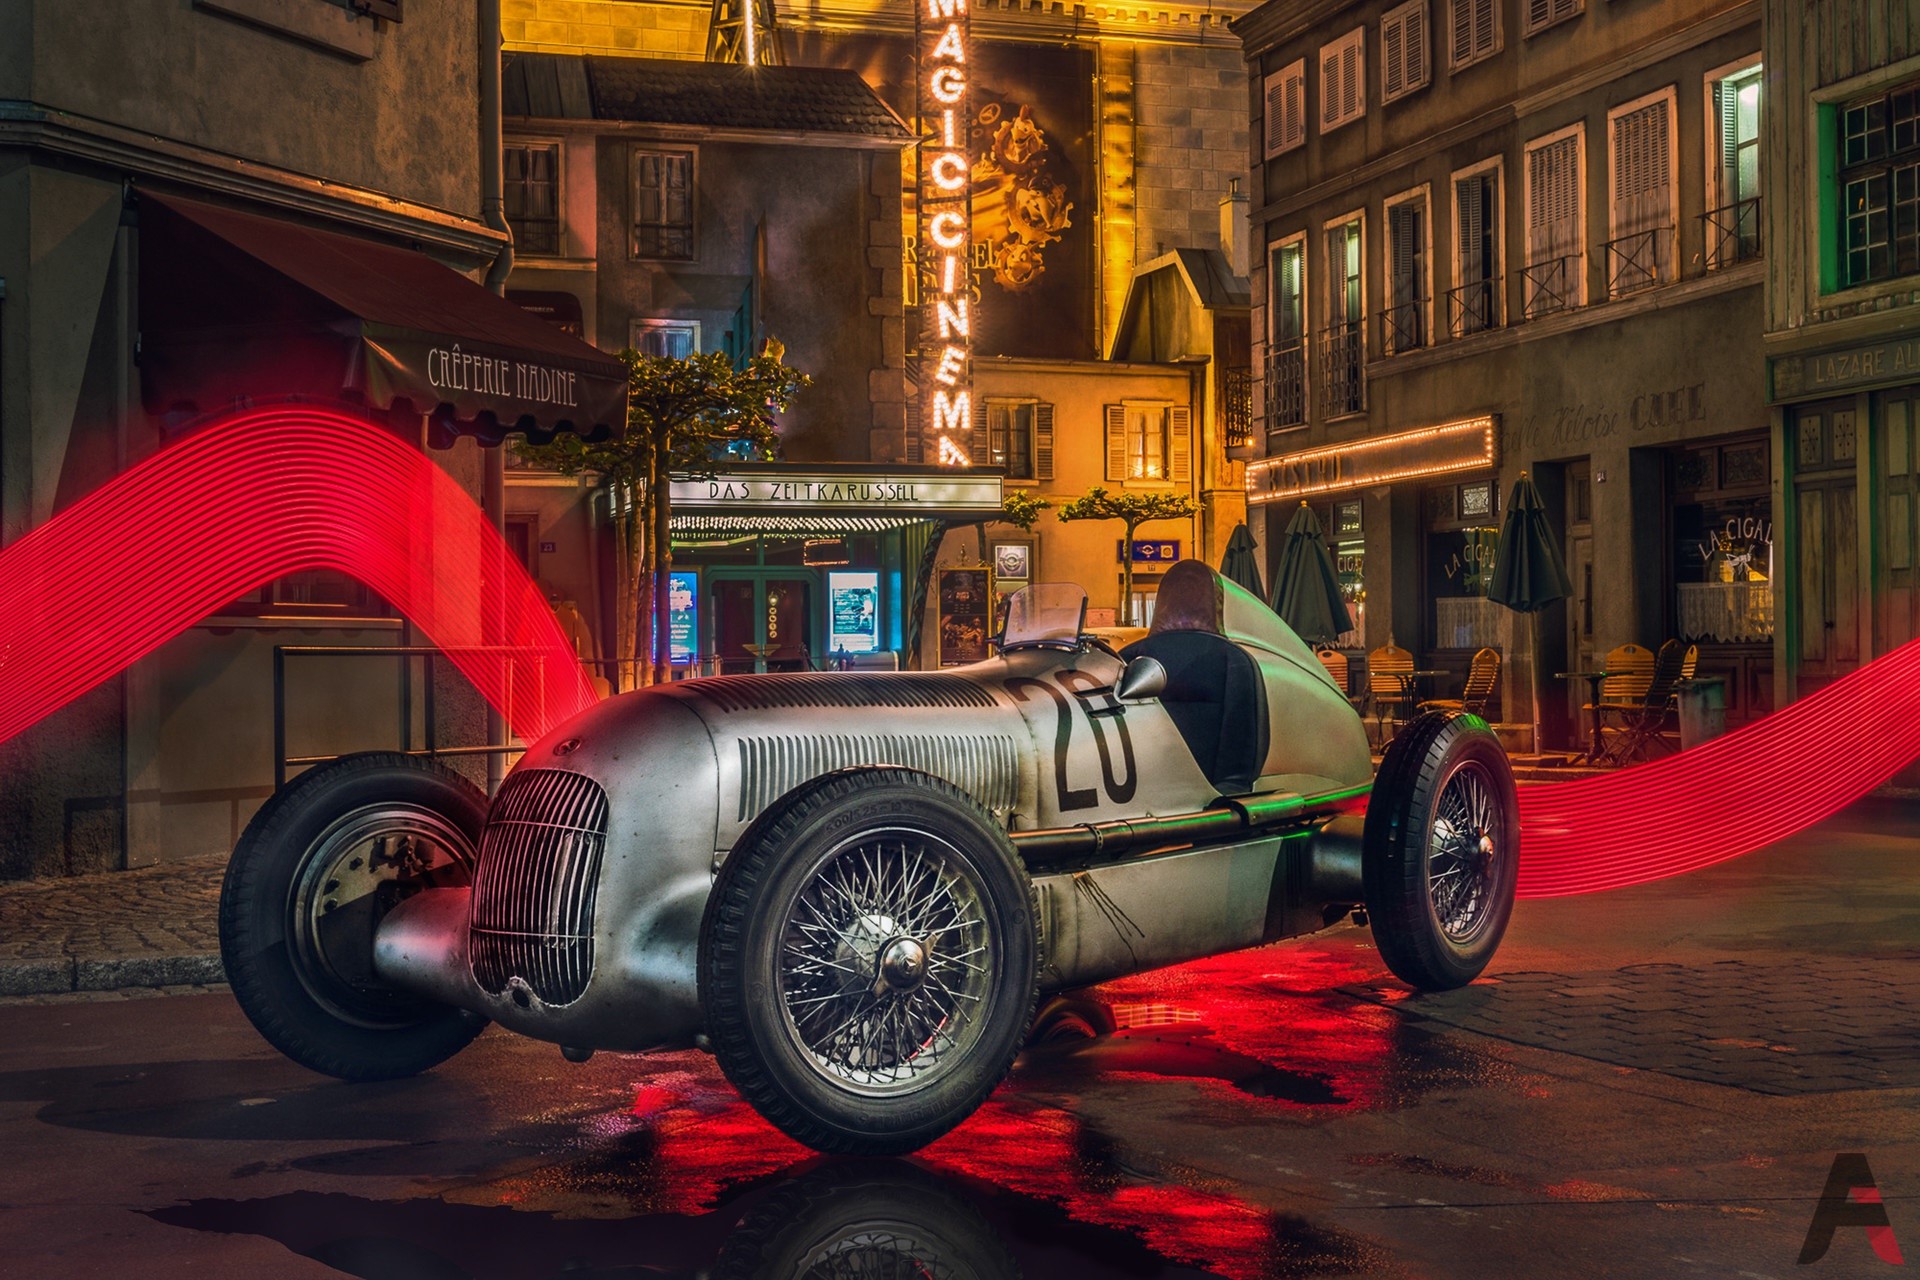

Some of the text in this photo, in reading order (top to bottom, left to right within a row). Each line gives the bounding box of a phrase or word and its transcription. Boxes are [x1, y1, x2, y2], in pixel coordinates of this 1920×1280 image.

[929, 210, 972, 467] CINEMA
[427, 343, 578, 407] CRÊPERIE NADINE
[1815, 341, 1920, 384] LAZARE AL
[709, 482, 919, 501] DAS ZEITKARUSSELL
[1267, 452, 1343, 493] BISTRO
[1444, 553, 1461, 579] LA
[1698, 529, 1721, 561] LA
[1003, 669, 1138, 813] 20
